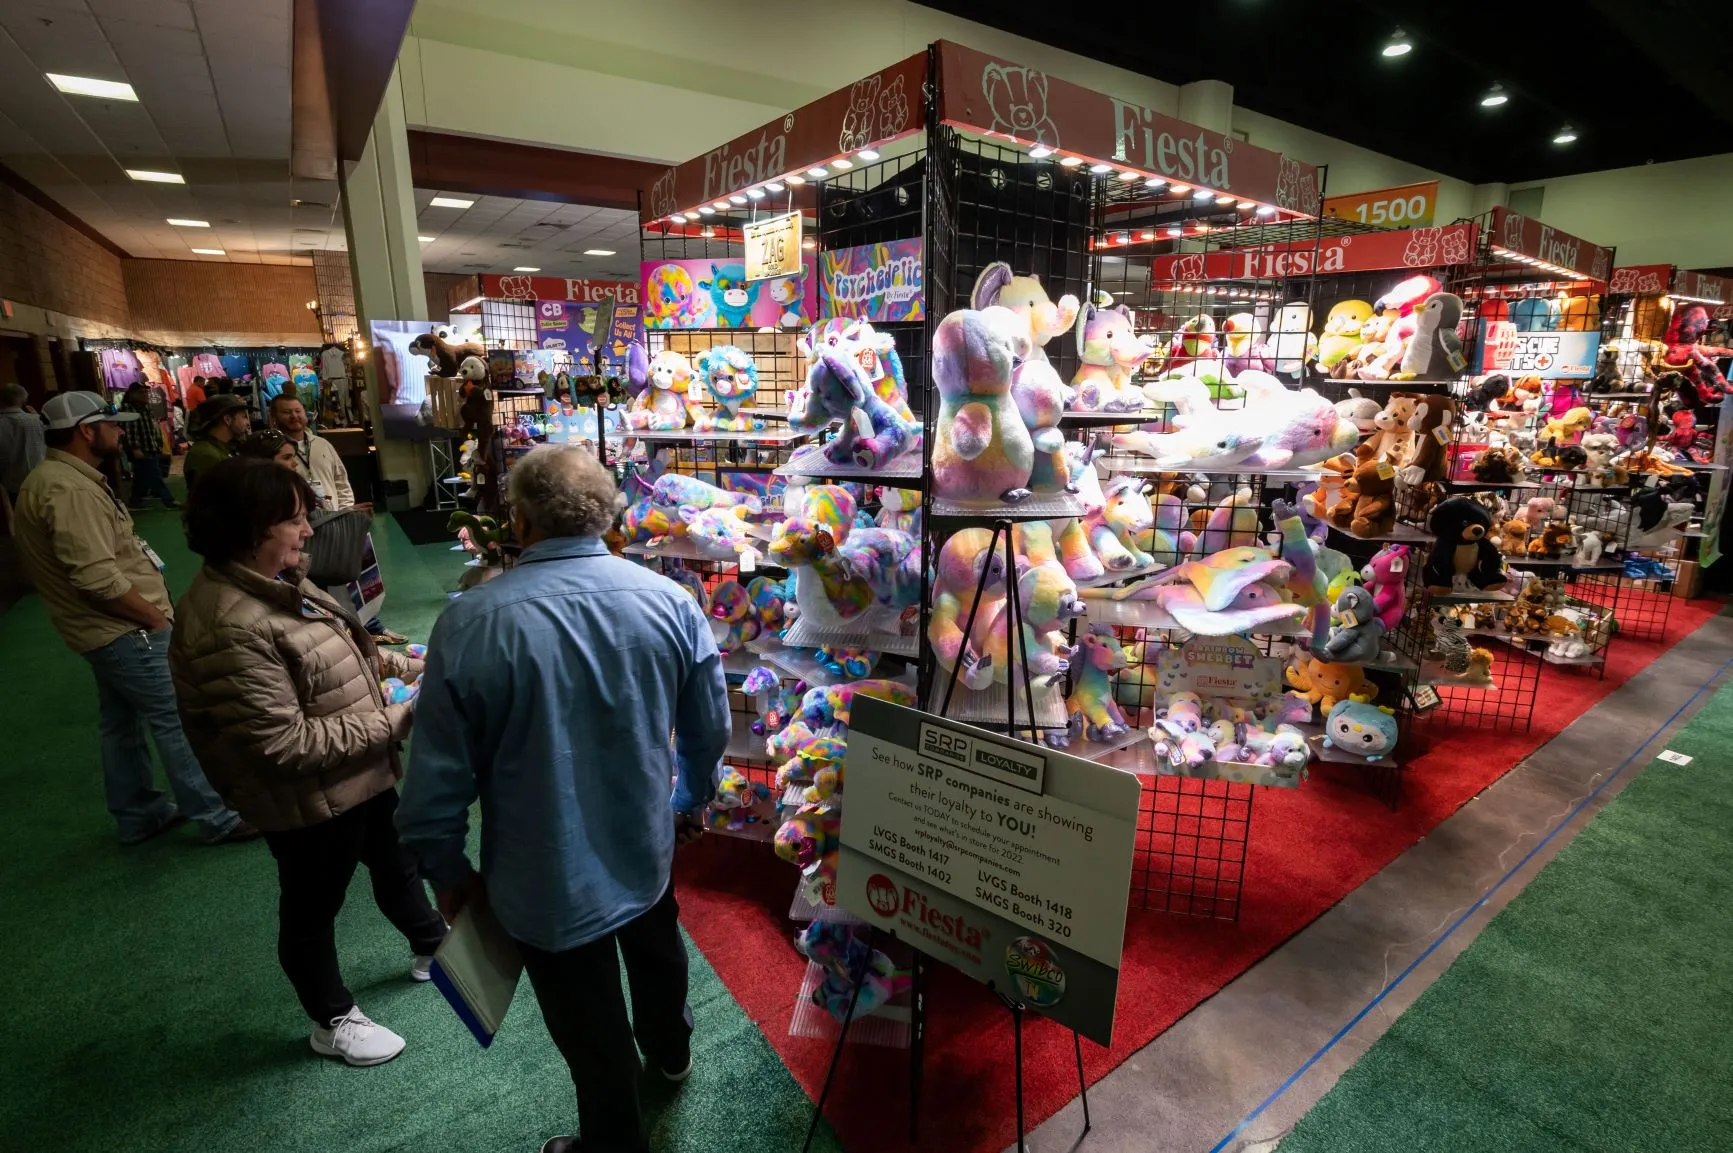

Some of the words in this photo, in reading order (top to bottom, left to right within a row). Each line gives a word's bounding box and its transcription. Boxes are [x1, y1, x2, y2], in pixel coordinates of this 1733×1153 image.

[1109, 98, 1231, 190] Fiesta
[702, 131, 786, 201] Fiesta
[1355, 195, 1426, 225] 1500
[761, 238, 785, 266] ZAG
[1242, 246, 1345, 279] Fiesta
[1538, 226, 1578, 269] Fiesta
[564, 278, 638, 303] Fiesta
[836, 260, 921, 298] Psychedelic
[541, 303, 562, 317] CB
[1516, 336, 1560, 353] SCUE
[924, 729, 967, 751] SRP
[981, 752, 1033, 776] LOYALTY
[871, 747, 890, 763] See
[894, 755, 914, 772] how
[917, 762, 943, 781] SRP
[946, 776, 1010, 807] companies
[1013, 801, 1034, 815] are
[1038, 806, 1094, 842] showing
[910, 783, 936, 801] their
[939, 791, 977, 820] loyalty
[980, 809, 993, 823] to
[997, 811, 1036, 839] YOU!
[873, 825, 897, 844] LVGS
[900, 835, 926, 857] Booth
[929, 849, 949, 866] 1417
[888, 792, 913, 808] Contact
[923, 804, 950, 822] TODAY
[951, 817, 959, 826] to
[960, 821, 991, 838] schedule
[992, 834, 1009, 848] your
[1011, 843, 1060, 866] appointment
[913, 816, 925, 826] and
[926, 821, 937, 829] see
[961, 833, 968, 841] in
[969, 836, 988, 850] store
[989, 843, 999, 853] for
[868, 839, 897, 860] SMGS
[899, 851, 925, 873] Booth
[927, 865, 952, 885] 1402
[914, 828, 1021, 877] srployalty@srpcompanies.com
[975, 887, 1009, 911] SMGS
[1012, 903, 1044, 927] Booth
[1047, 919, 1072, 938] 320
[978, 869, 1007, 891] LVGS
[1010, 883, 1042, 908] Booth
[1046, 900, 1073, 920] 1418
[902, 886, 982, 949] Fiesta
